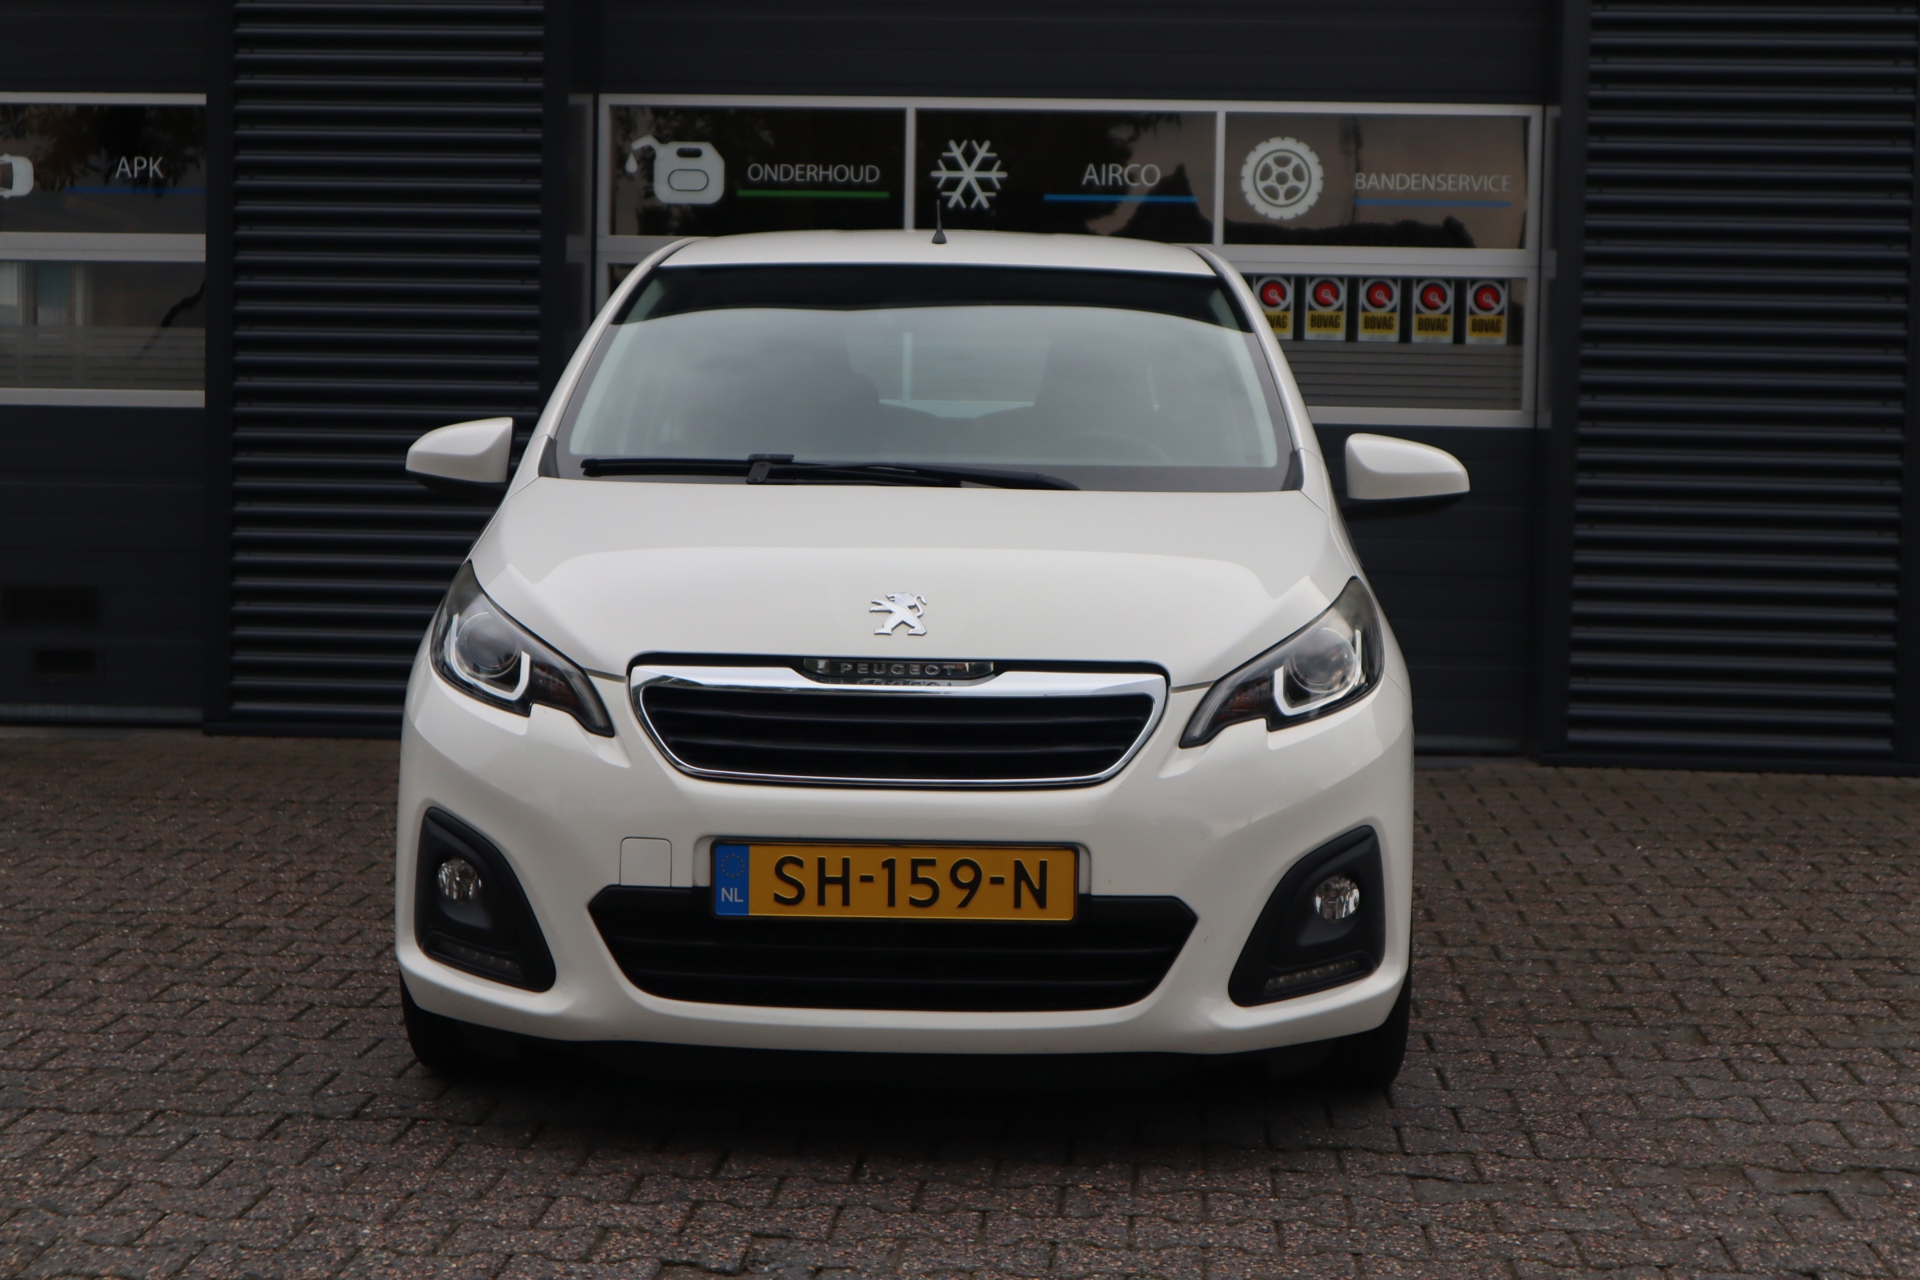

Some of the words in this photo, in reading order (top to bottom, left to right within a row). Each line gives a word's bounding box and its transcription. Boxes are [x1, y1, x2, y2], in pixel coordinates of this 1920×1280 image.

[115, 156, 164, 179] APK
[747, 163, 881, 184] ONDERHOUD
[1081, 162, 1161, 187] AIRCO
[1354, 172, 1511, 193] BANDENSERVICE
[1310, 315, 1341, 329] BOVAG
[1364, 316, 1394, 330] BOVAG
[1418, 317, 1448, 331] BOVAG
[1472, 318, 1502, 332] BOVAG
[840, 662, 957, 676] PEUGEOT
[773, 854, 1048, 909] SH-159-N
[721, 887, 744, 903] NL
